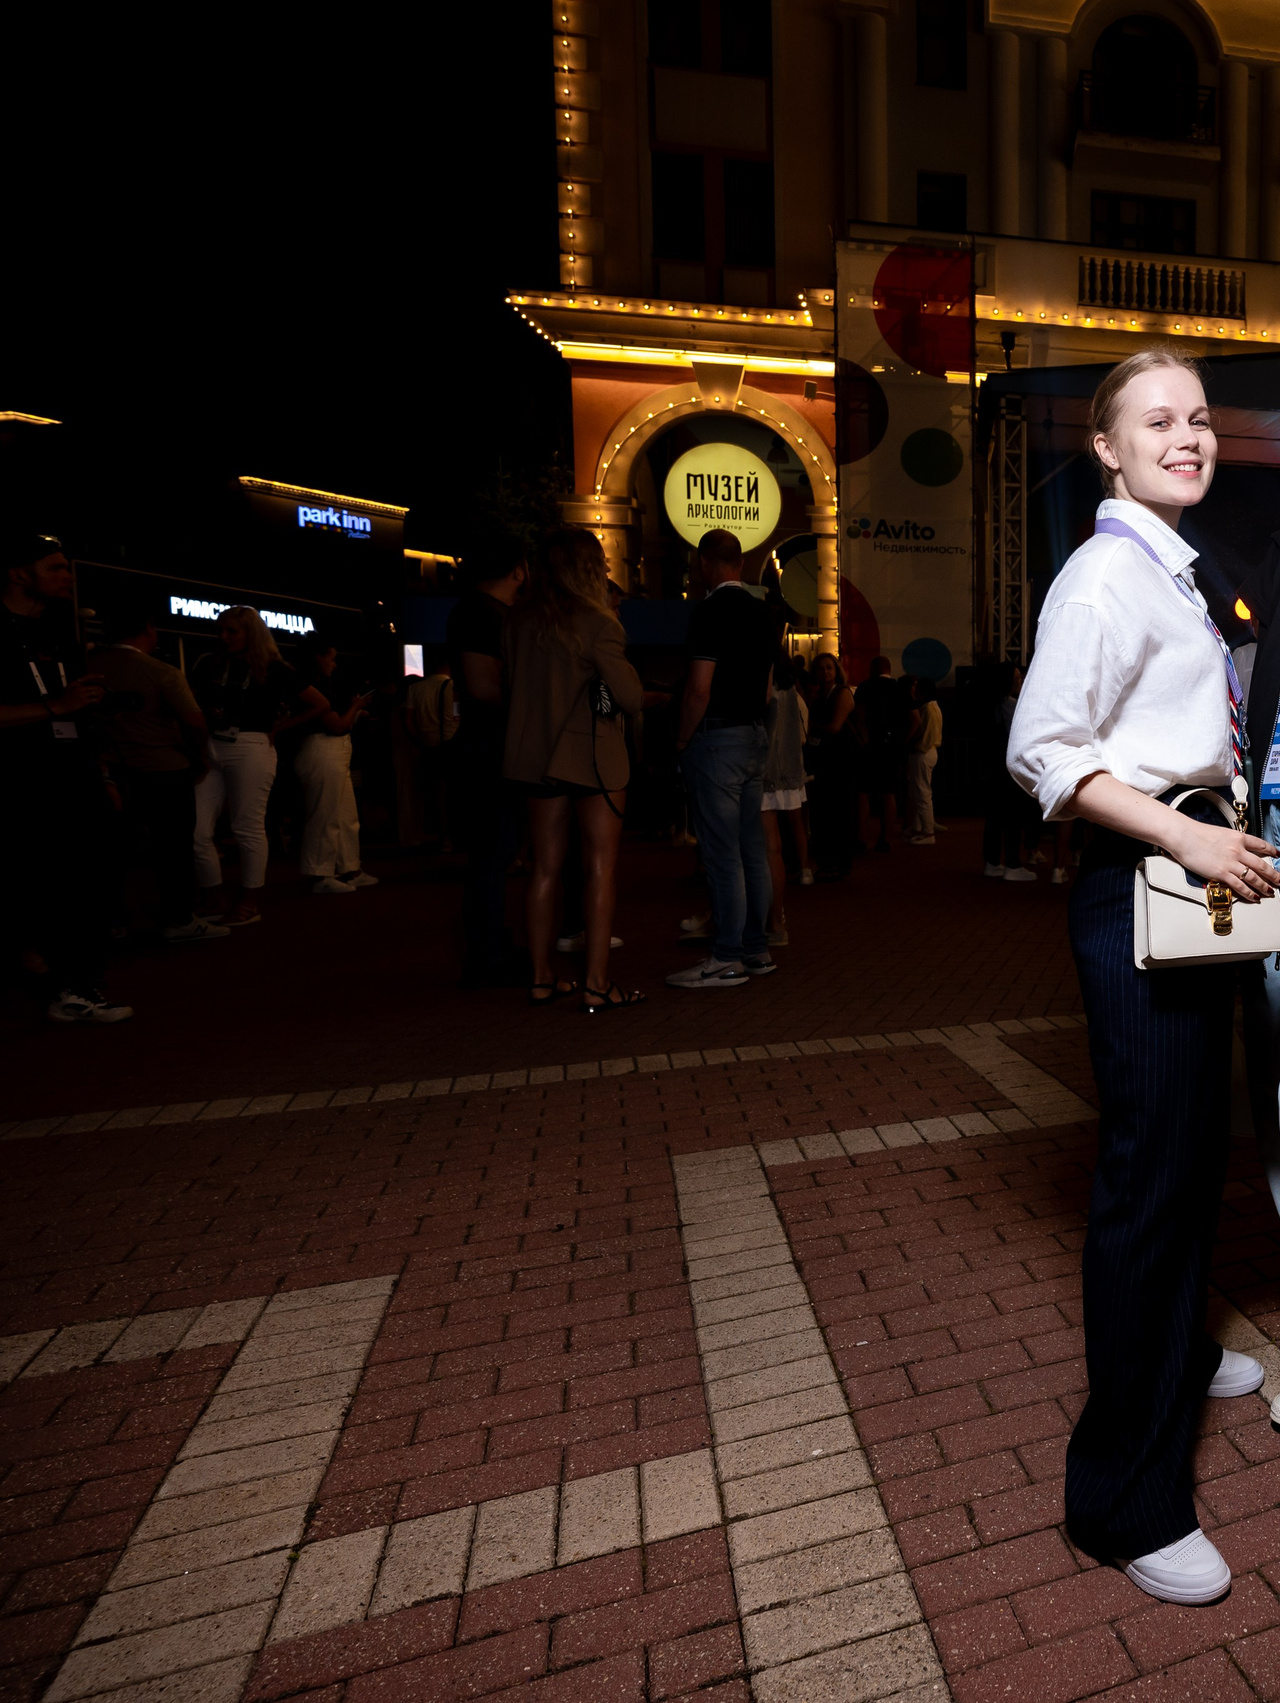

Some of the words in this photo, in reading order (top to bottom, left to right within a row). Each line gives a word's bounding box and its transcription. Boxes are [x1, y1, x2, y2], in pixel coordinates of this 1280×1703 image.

[686, 471, 759, 503] МУЗЕЙ
[298, 505, 341, 527] park
[342, 509, 371, 532] inn
[687, 503, 760, 522] АРХЕОЛОГИИ
[873, 519, 935, 540] Avito
[873, 541, 967, 555] Недвижимость
[260, 610, 315, 635] ПИЦЦА
